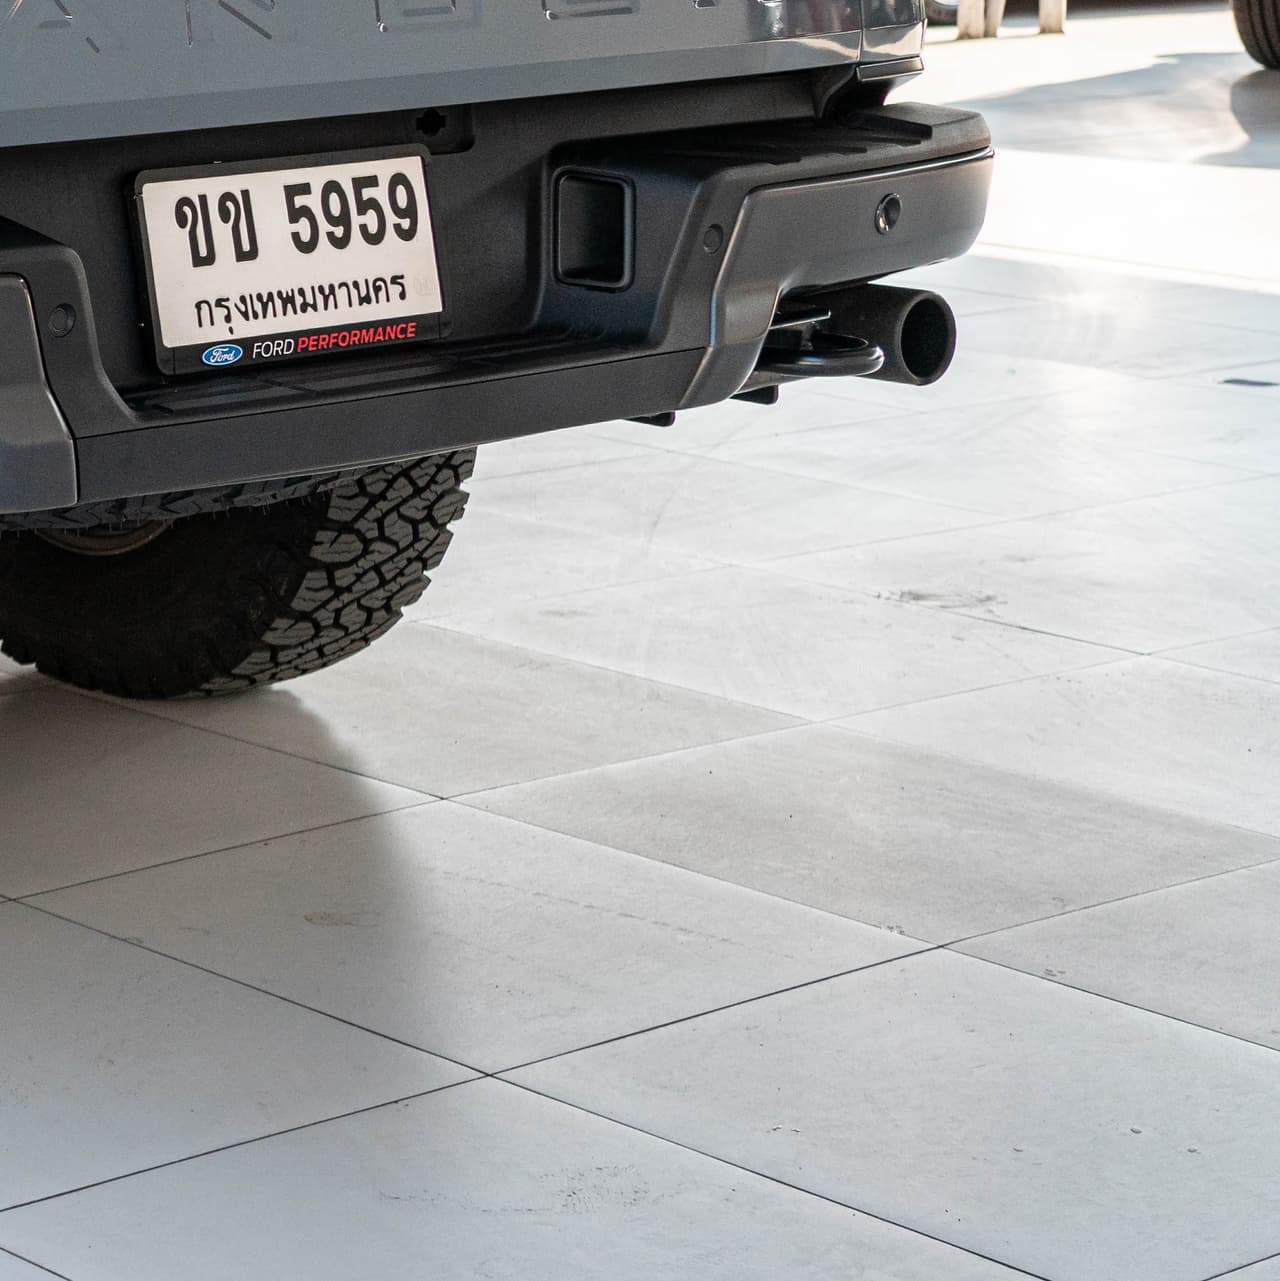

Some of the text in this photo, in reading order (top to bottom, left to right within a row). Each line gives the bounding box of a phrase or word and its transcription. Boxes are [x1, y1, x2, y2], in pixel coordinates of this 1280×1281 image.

[174, 171, 419, 268] ขข 5959
[194, 274, 407, 335] กรุงเทพมหานคร
[252, 322, 417, 359] FORD PERFORMANCE
